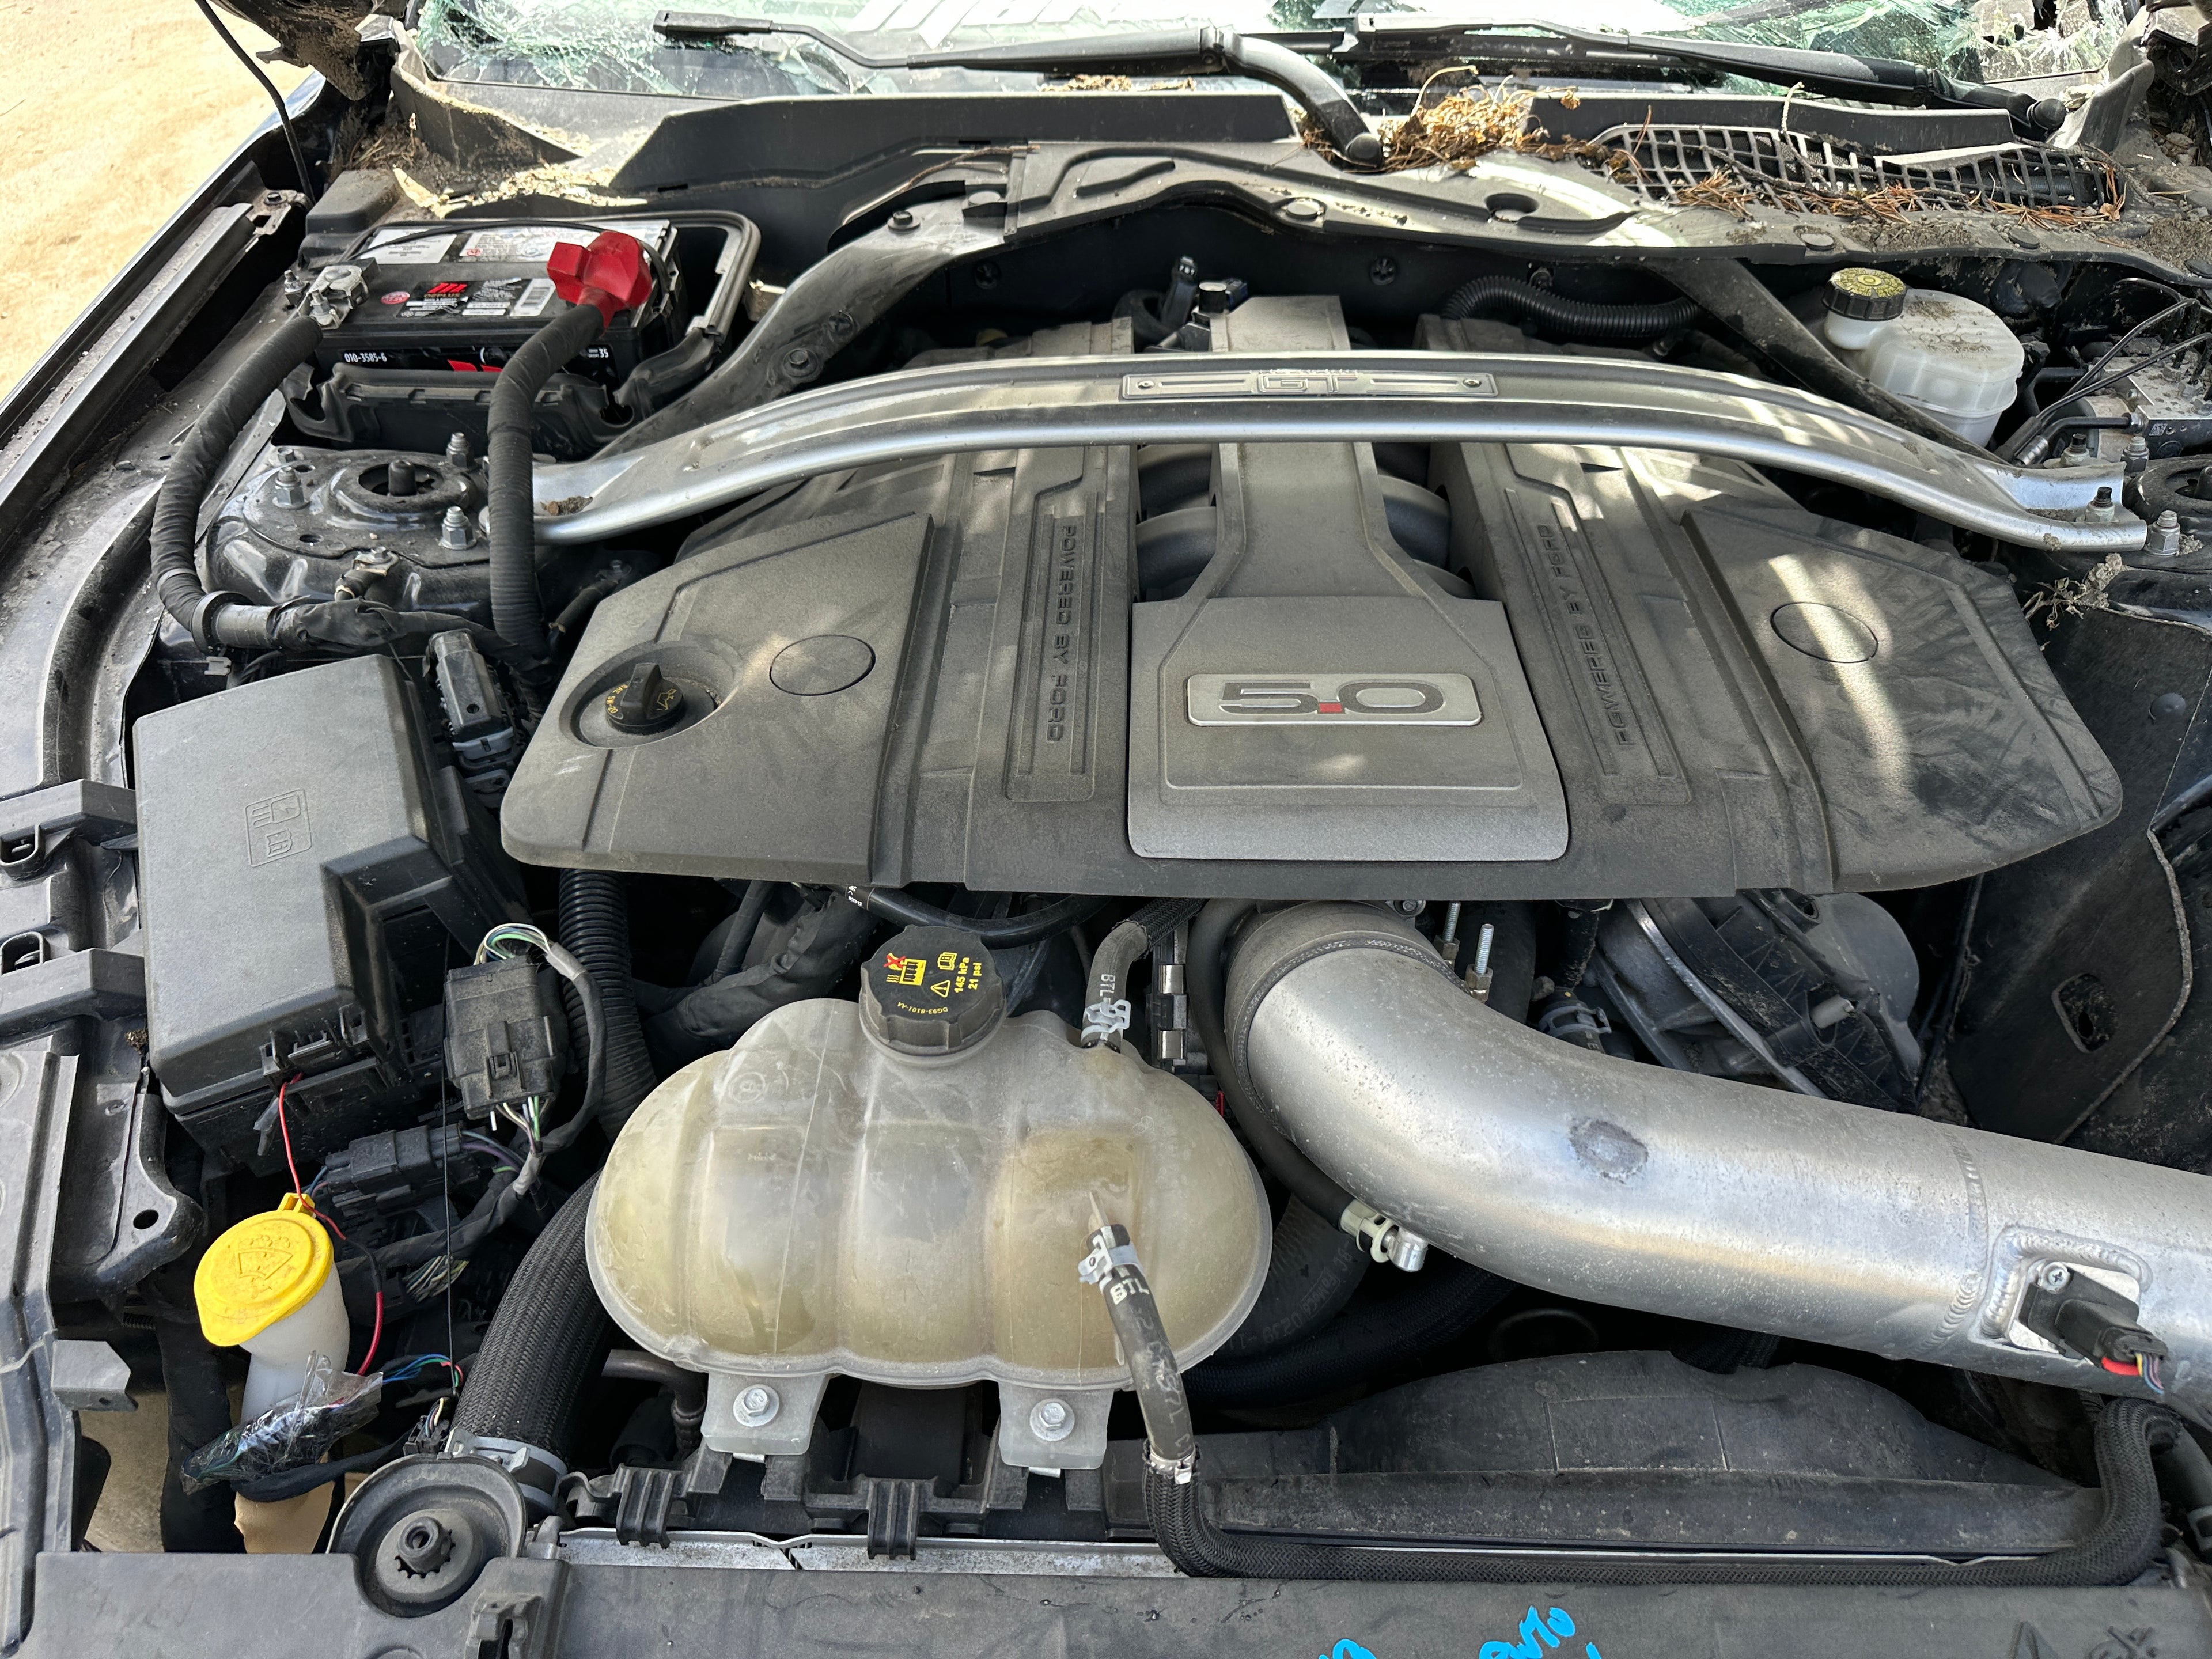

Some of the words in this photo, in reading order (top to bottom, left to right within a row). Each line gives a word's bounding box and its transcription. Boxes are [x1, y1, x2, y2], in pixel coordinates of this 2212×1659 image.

[343, 352, 388, 363] 010-3585-6
[599, 347, 609, 358] 35
[1257, 372, 1359, 393] GT
[1537, 524, 1571, 579] FORD
[1055, 525, 1077, 626] POWERED
[1559, 586, 1582, 615] BY
[1053, 634, 1073, 665] BY
[1574, 624, 1638, 746] POWERED
[606, 695, 618, 714] 5W-20
[1046, 674, 1069, 743] FORD
[1219, 680, 1446, 715] 5.0
[957, 957, 970, 975] kPa
[972, 962, 982, 976] psi
[954, 976, 966, 993] 145
[968, 979, 979, 990] 21
[1100, 974, 1116, 997] BTL
[897, 1001, 949, 1014] DG93-8101-AA
[1109, 1278, 1150, 1305] BTL
